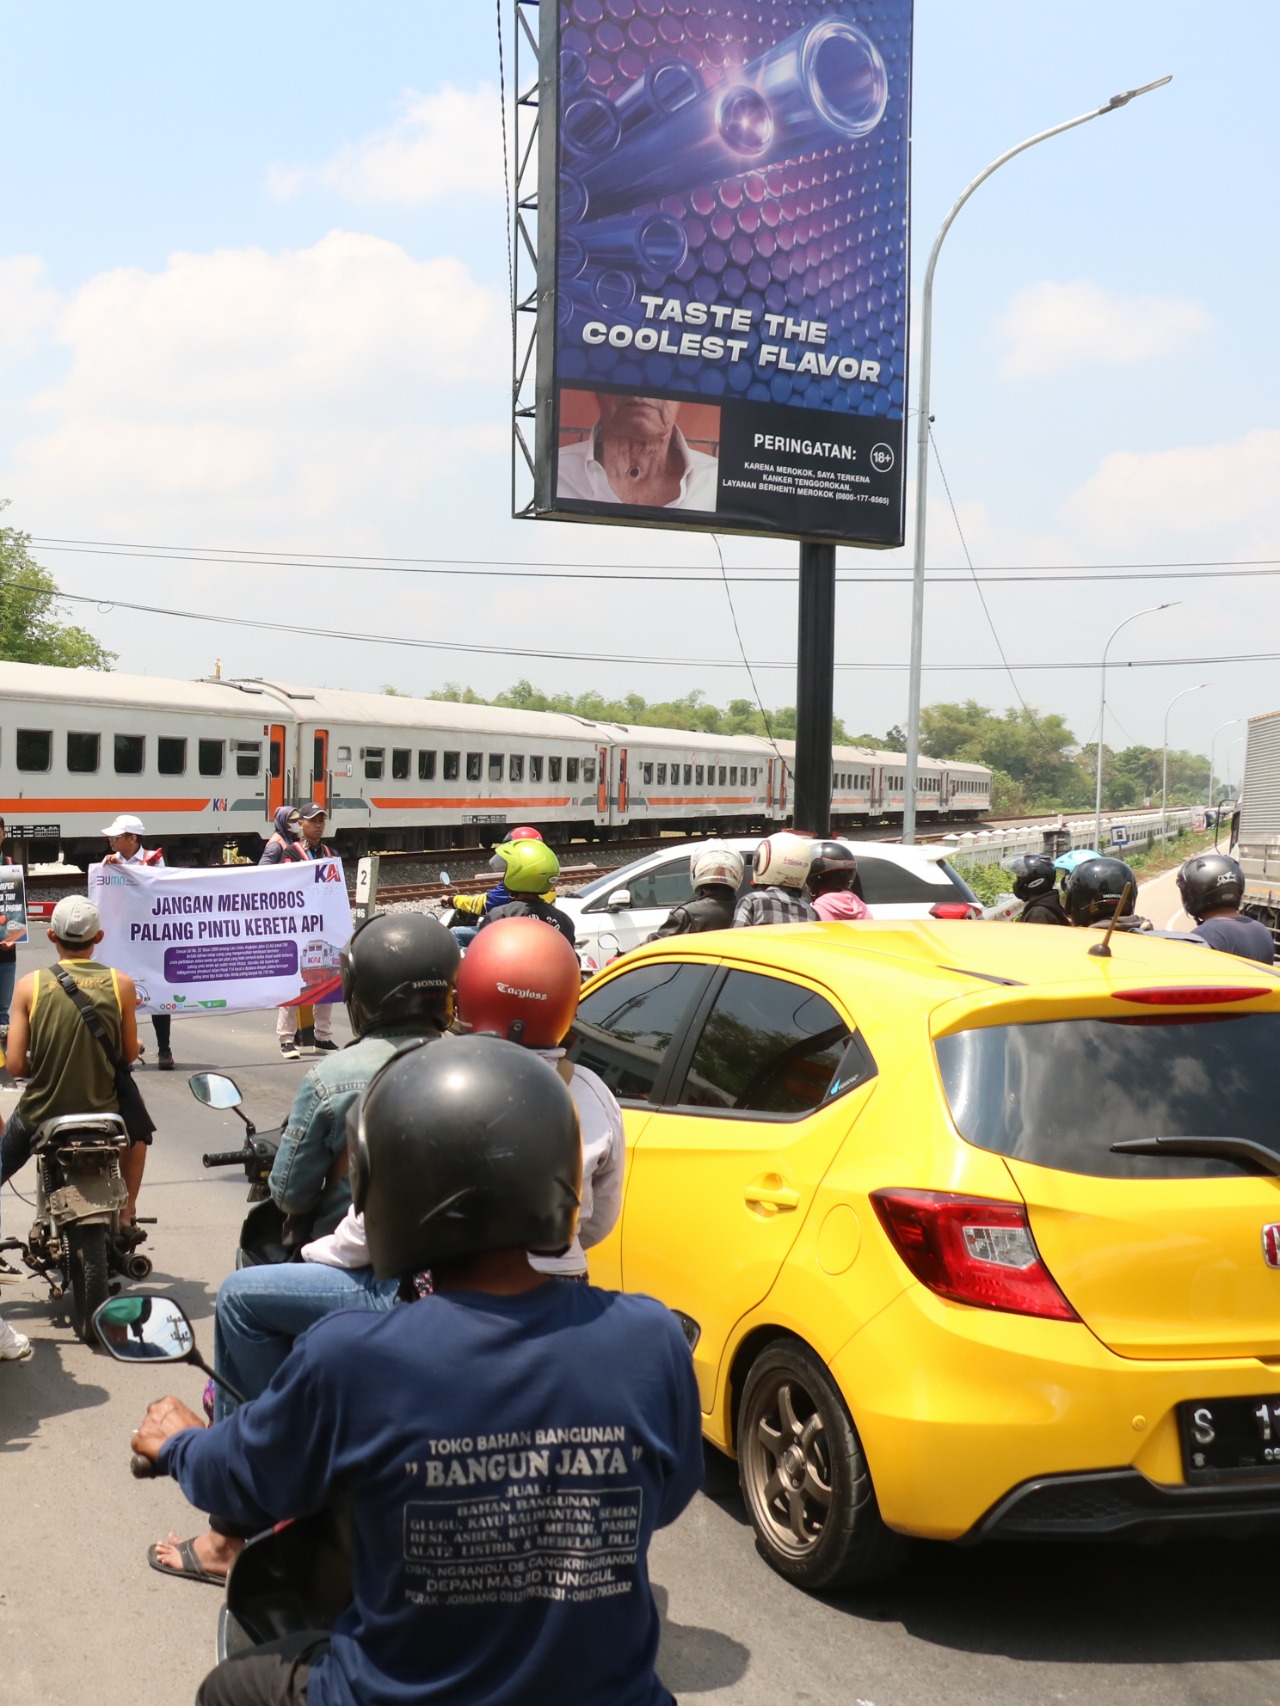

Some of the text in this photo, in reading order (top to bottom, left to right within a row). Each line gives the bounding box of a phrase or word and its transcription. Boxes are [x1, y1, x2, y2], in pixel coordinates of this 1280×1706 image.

[640, 295, 828, 345] TASTE THE
[581, 321, 881, 383] COOLEST FLAVOR
[754, 433, 857, 460] PERINGATAN:
[744, 461, 871, 484] KARENA MEROKOK, SAYA TERKENA
[762, 474, 852, 491] KANKER TENGGOROKAN.
[722, 479, 757, 490] LAYANAN
[758, 482, 796, 495] BERHENTI
[796, 488, 834, 499] MEROKOK
[360, 869, 368, 885] 2
[151, 890, 305, 916] JANGAN MENEROBOS
[130, 914, 324, 942] PALANG PINTU KERETA API
[411, 979, 449, 989] HONDA
[1193, 1408, 1216, 1444] S
[429, 1426, 625, 1456] TOKO BAHAN BANGUNAN
[457, 1495, 601, 1517] BAHAN BANGUNAN
[468, 1512, 504, 1529] KAYU
[599, 1505, 638, 1519] SEMEN
[509, 1523, 540, 1539] BATA
[601, 1518, 637, 1532] PASIR
[462, 1541, 517, 1557] LISTRIK
[426, 1568, 616, 1592] DEPAN MASJID TUNGGUL
